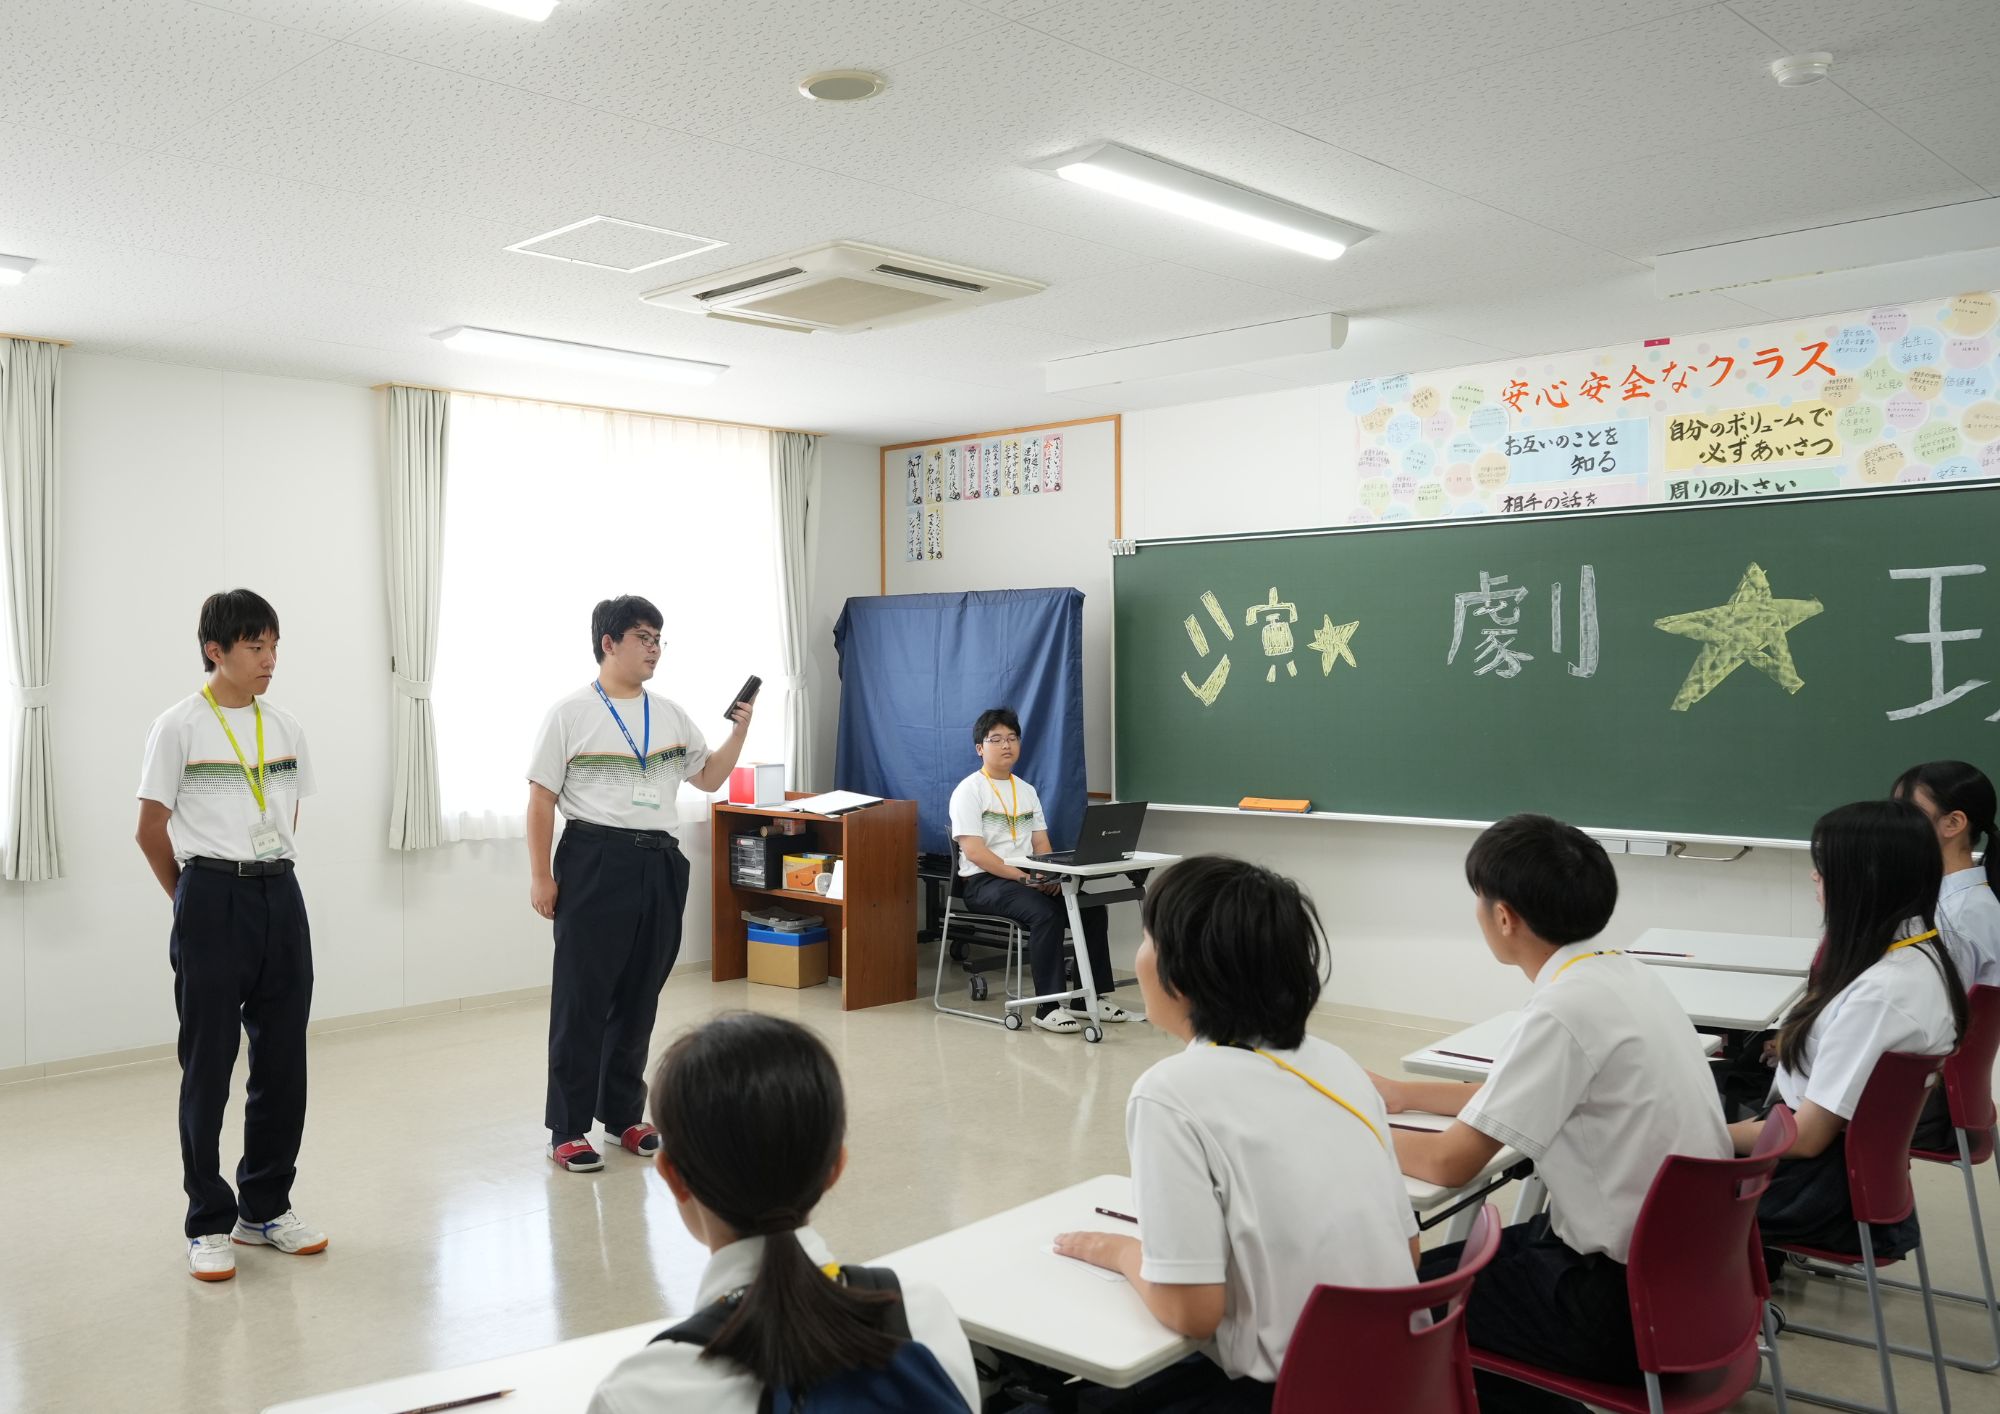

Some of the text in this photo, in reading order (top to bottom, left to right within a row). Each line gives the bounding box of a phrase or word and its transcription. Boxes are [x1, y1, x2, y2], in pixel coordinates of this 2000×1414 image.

[1502, 341, 1836, 413] 安心安全なクラス
[1670, 407, 1833, 441] 自分のボリュームで
[1505, 427, 1619, 456] お互いのことを
[1699, 434, 1834, 464] 必ずあいさつ
[1570, 451, 1616, 475] 知る
[1501, 491, 1598, 513] 相手の話を
[1670, 478, 1797, 500] 周りの小さい
